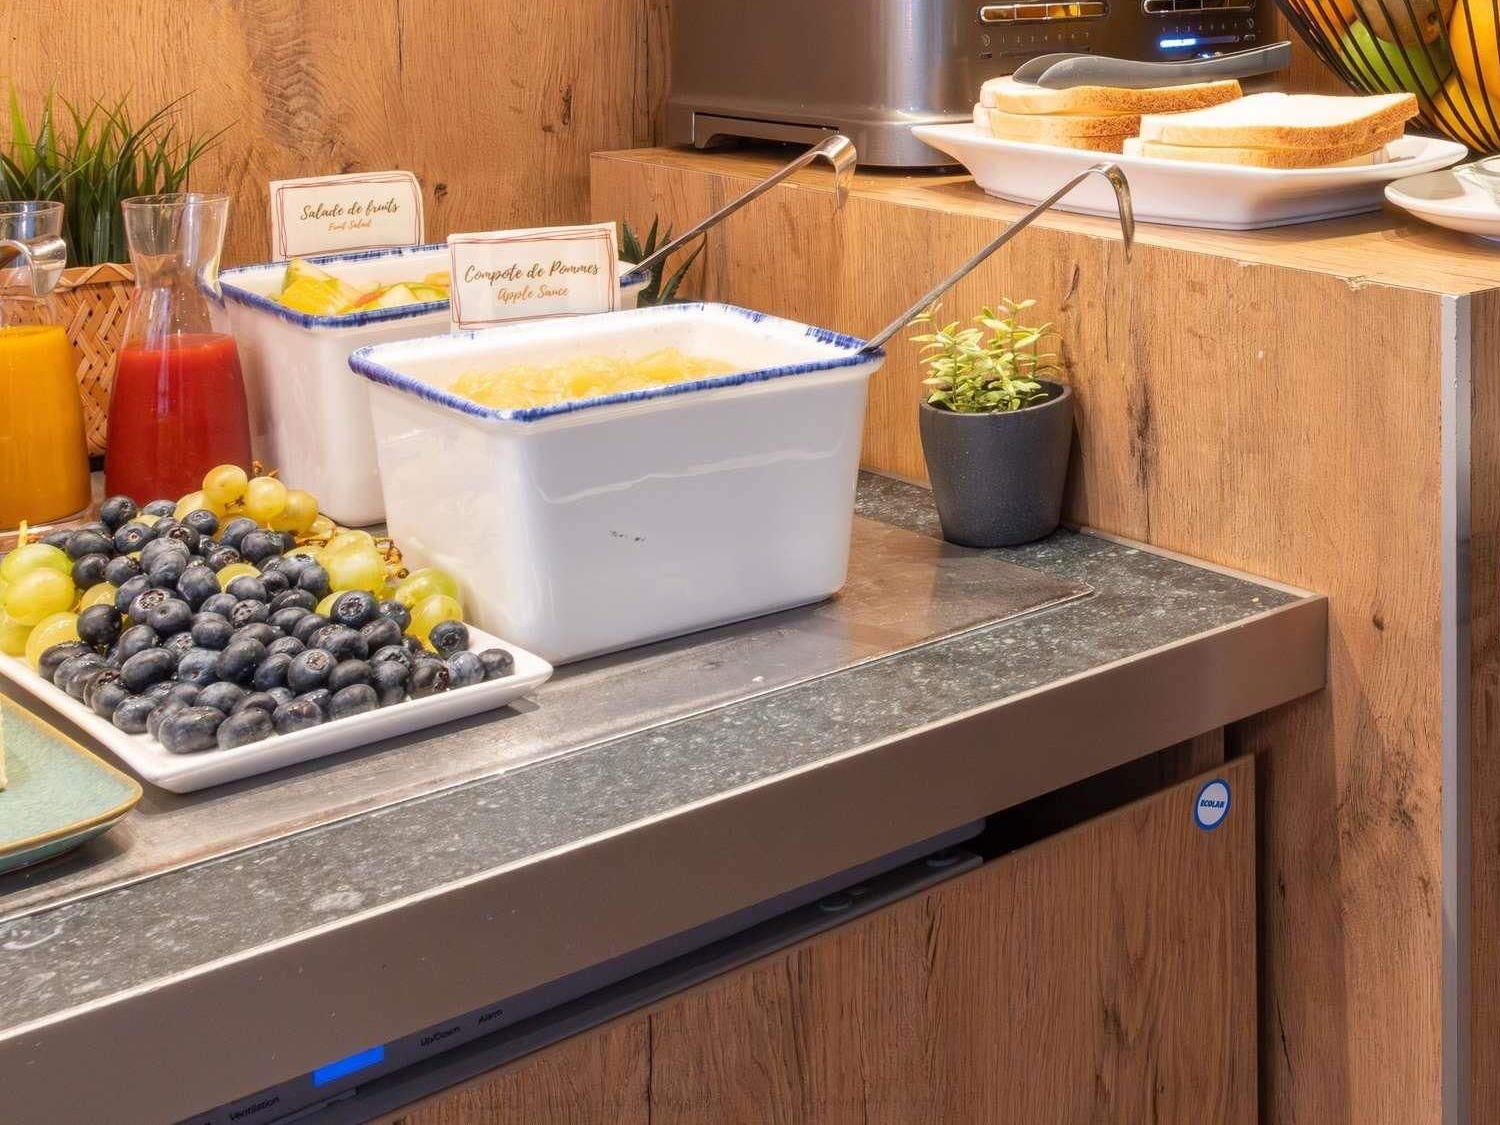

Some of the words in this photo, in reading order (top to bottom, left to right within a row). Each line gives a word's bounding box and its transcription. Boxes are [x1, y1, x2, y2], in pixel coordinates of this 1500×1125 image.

[300, 202, 344, 221] Salade
[347, 201, 361, 214] de
[365, 197, 399, 216] fruits
[349, 218, 373, 229] Salad
[464, 263, 523, 287] Compote
[526, 262, 544, 279] de
[549, 259, 601, 277] Pommes
[537, 283, 570, 299] Sauce
